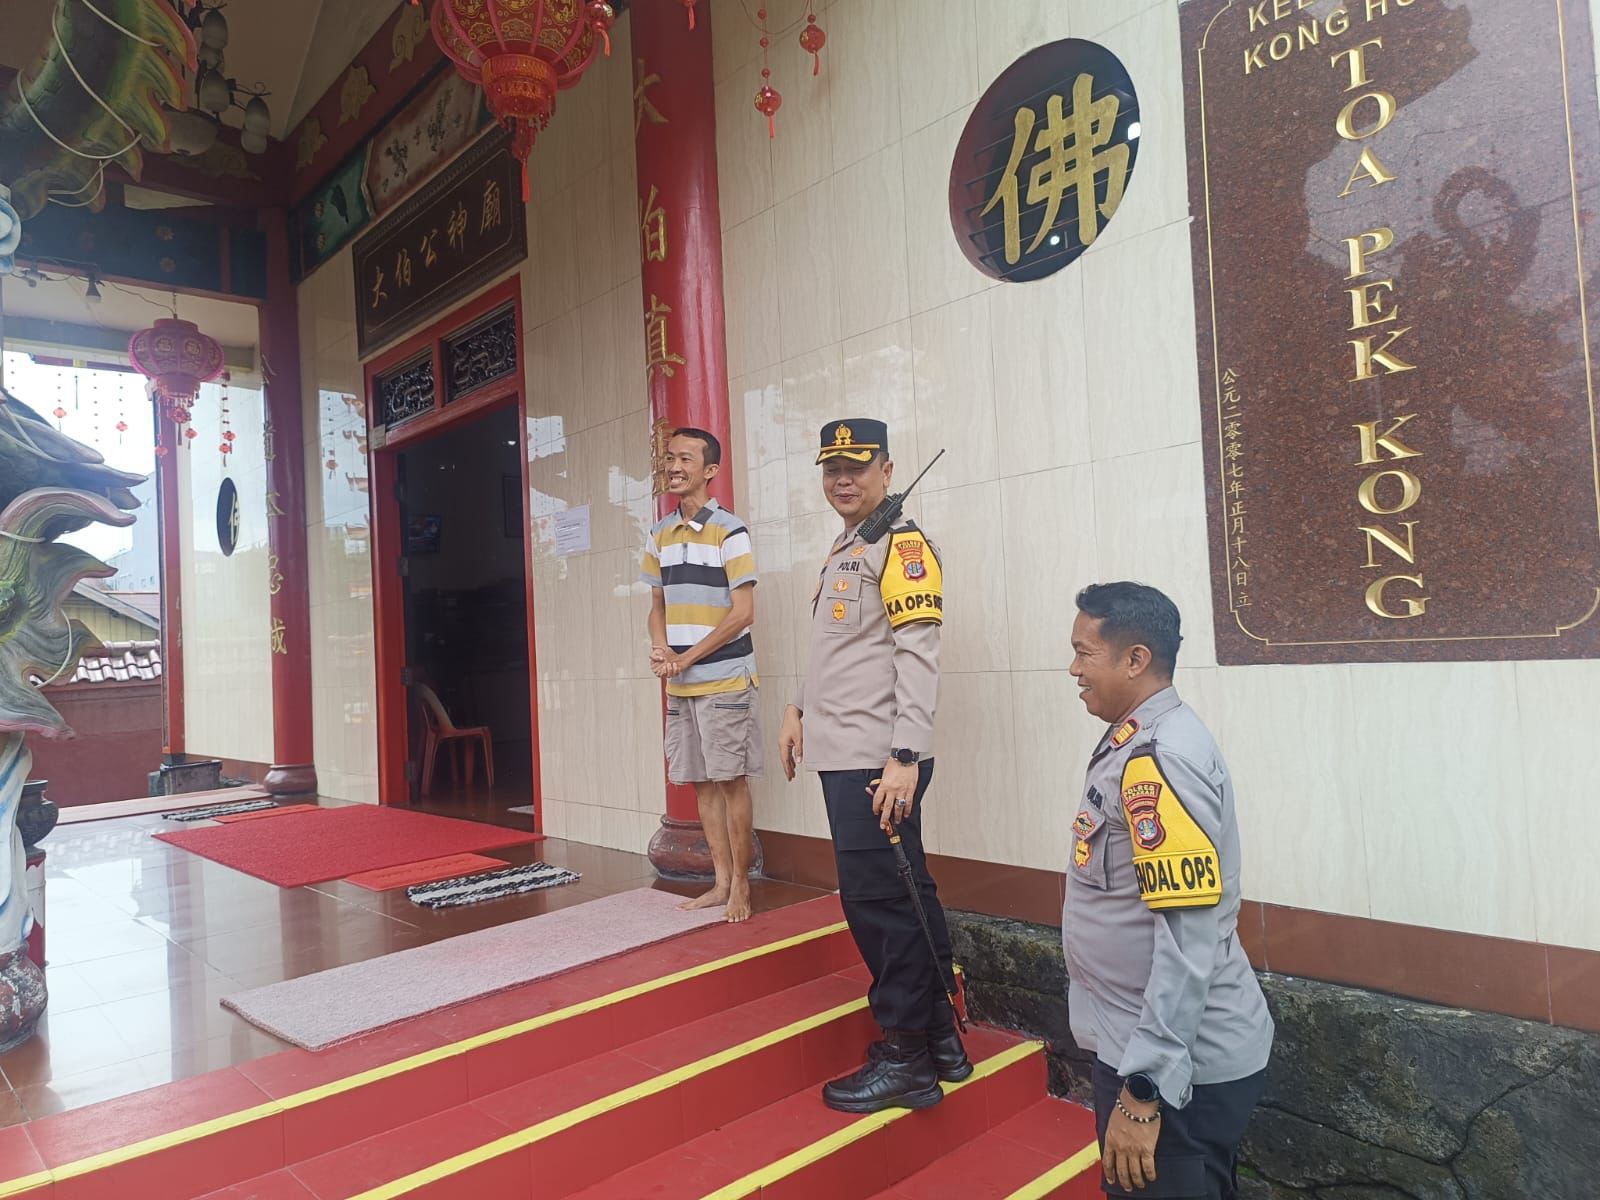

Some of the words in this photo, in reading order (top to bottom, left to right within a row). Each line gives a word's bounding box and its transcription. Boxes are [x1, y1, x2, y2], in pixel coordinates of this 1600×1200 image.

[1243, 9, 1350, 75] KONG
[979, 72, 1130, 265] 佛
[1330, 37, 1398, 198] TOA
[1341, 226, 1417, 383] PEK
[837, 560, 860, 572] POLRI
[1352, 413, 1431, 619] KONG
[886, 599, 904, 617] KA
[905, 593, 933, 611] OPS
[1181, 855, 1216, 890] OPS
